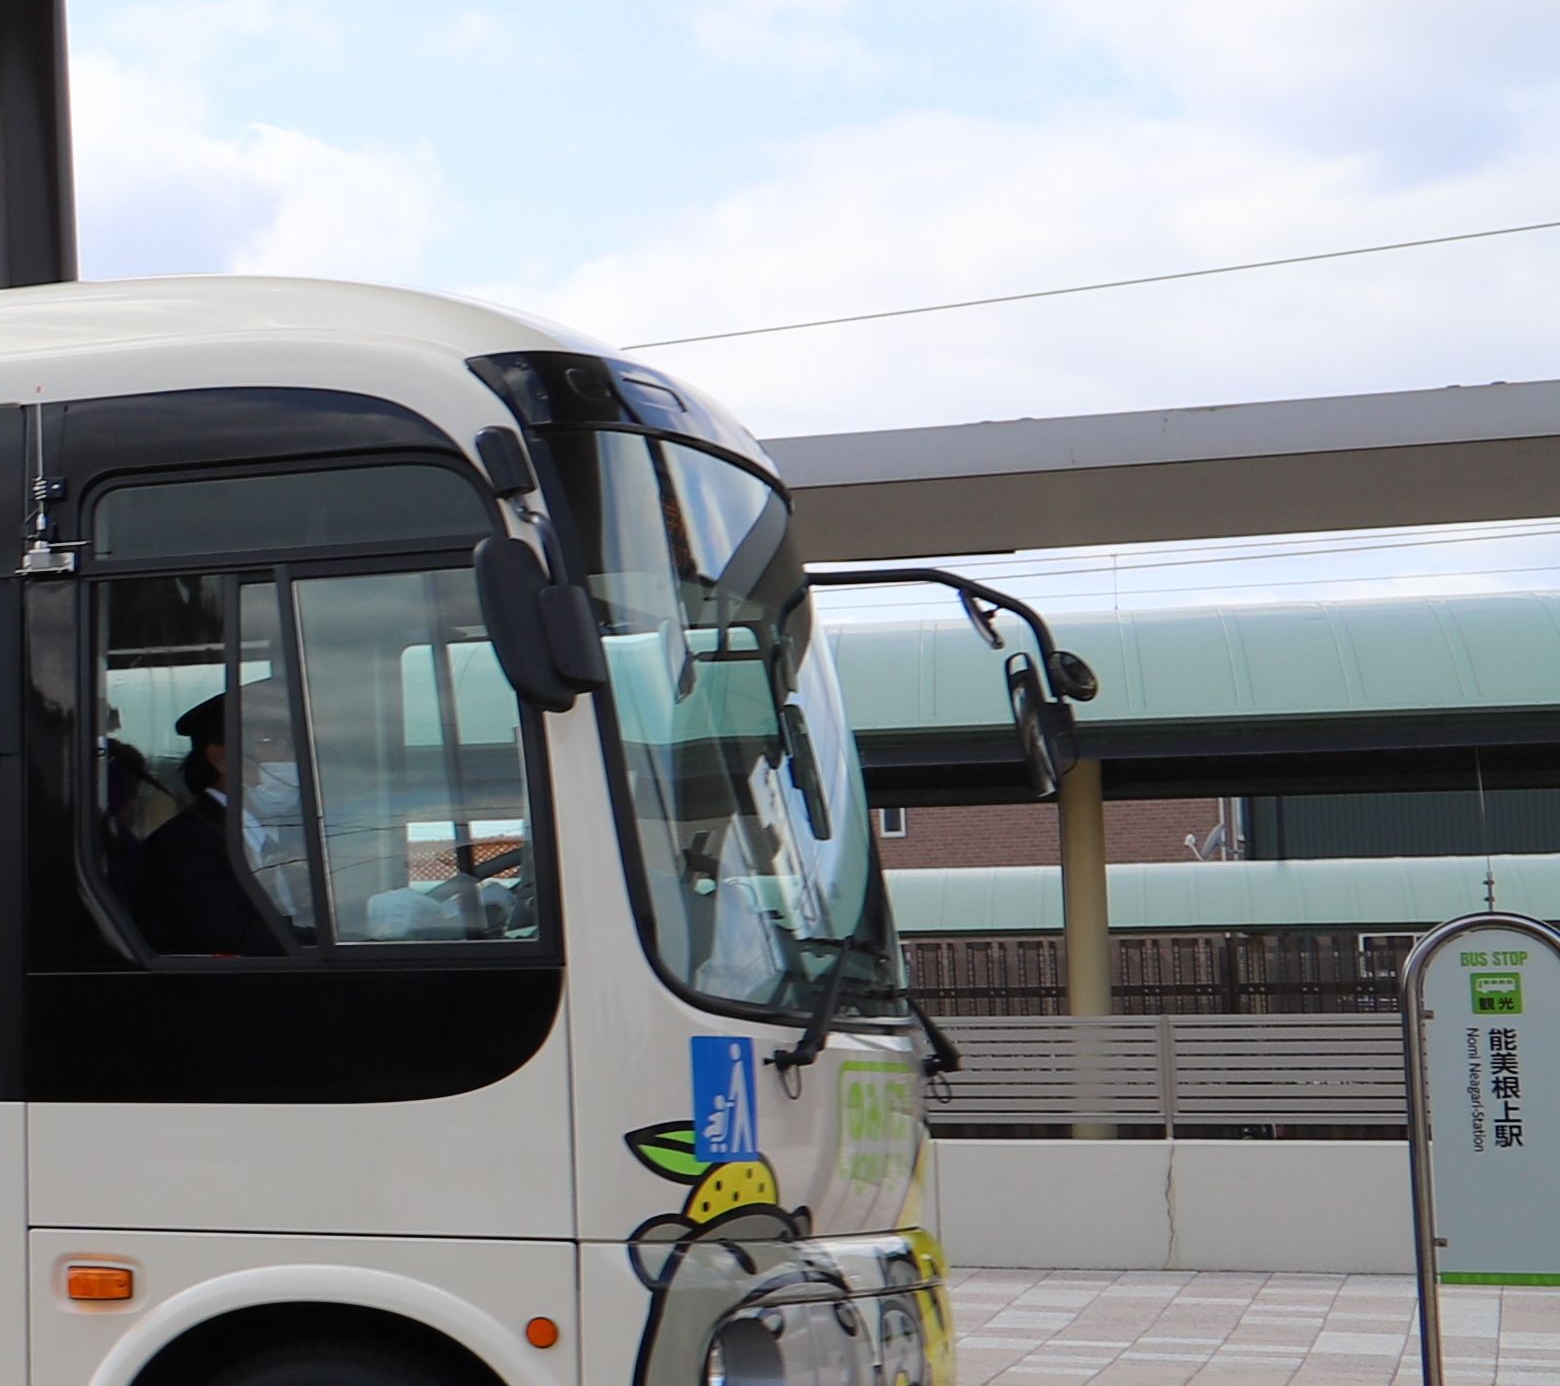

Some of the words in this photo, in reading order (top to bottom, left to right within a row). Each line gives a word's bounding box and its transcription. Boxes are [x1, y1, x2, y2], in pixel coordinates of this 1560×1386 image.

[1460, 952, 1488, 967] BUS
[1492, 951, 1529, 966] STOP
[1479, 997, 1515, 1011] 観光
[1466, 1027, 1480, 1059] Nomi
[1488, 1027, 1524, 1148] 能美根上駅
